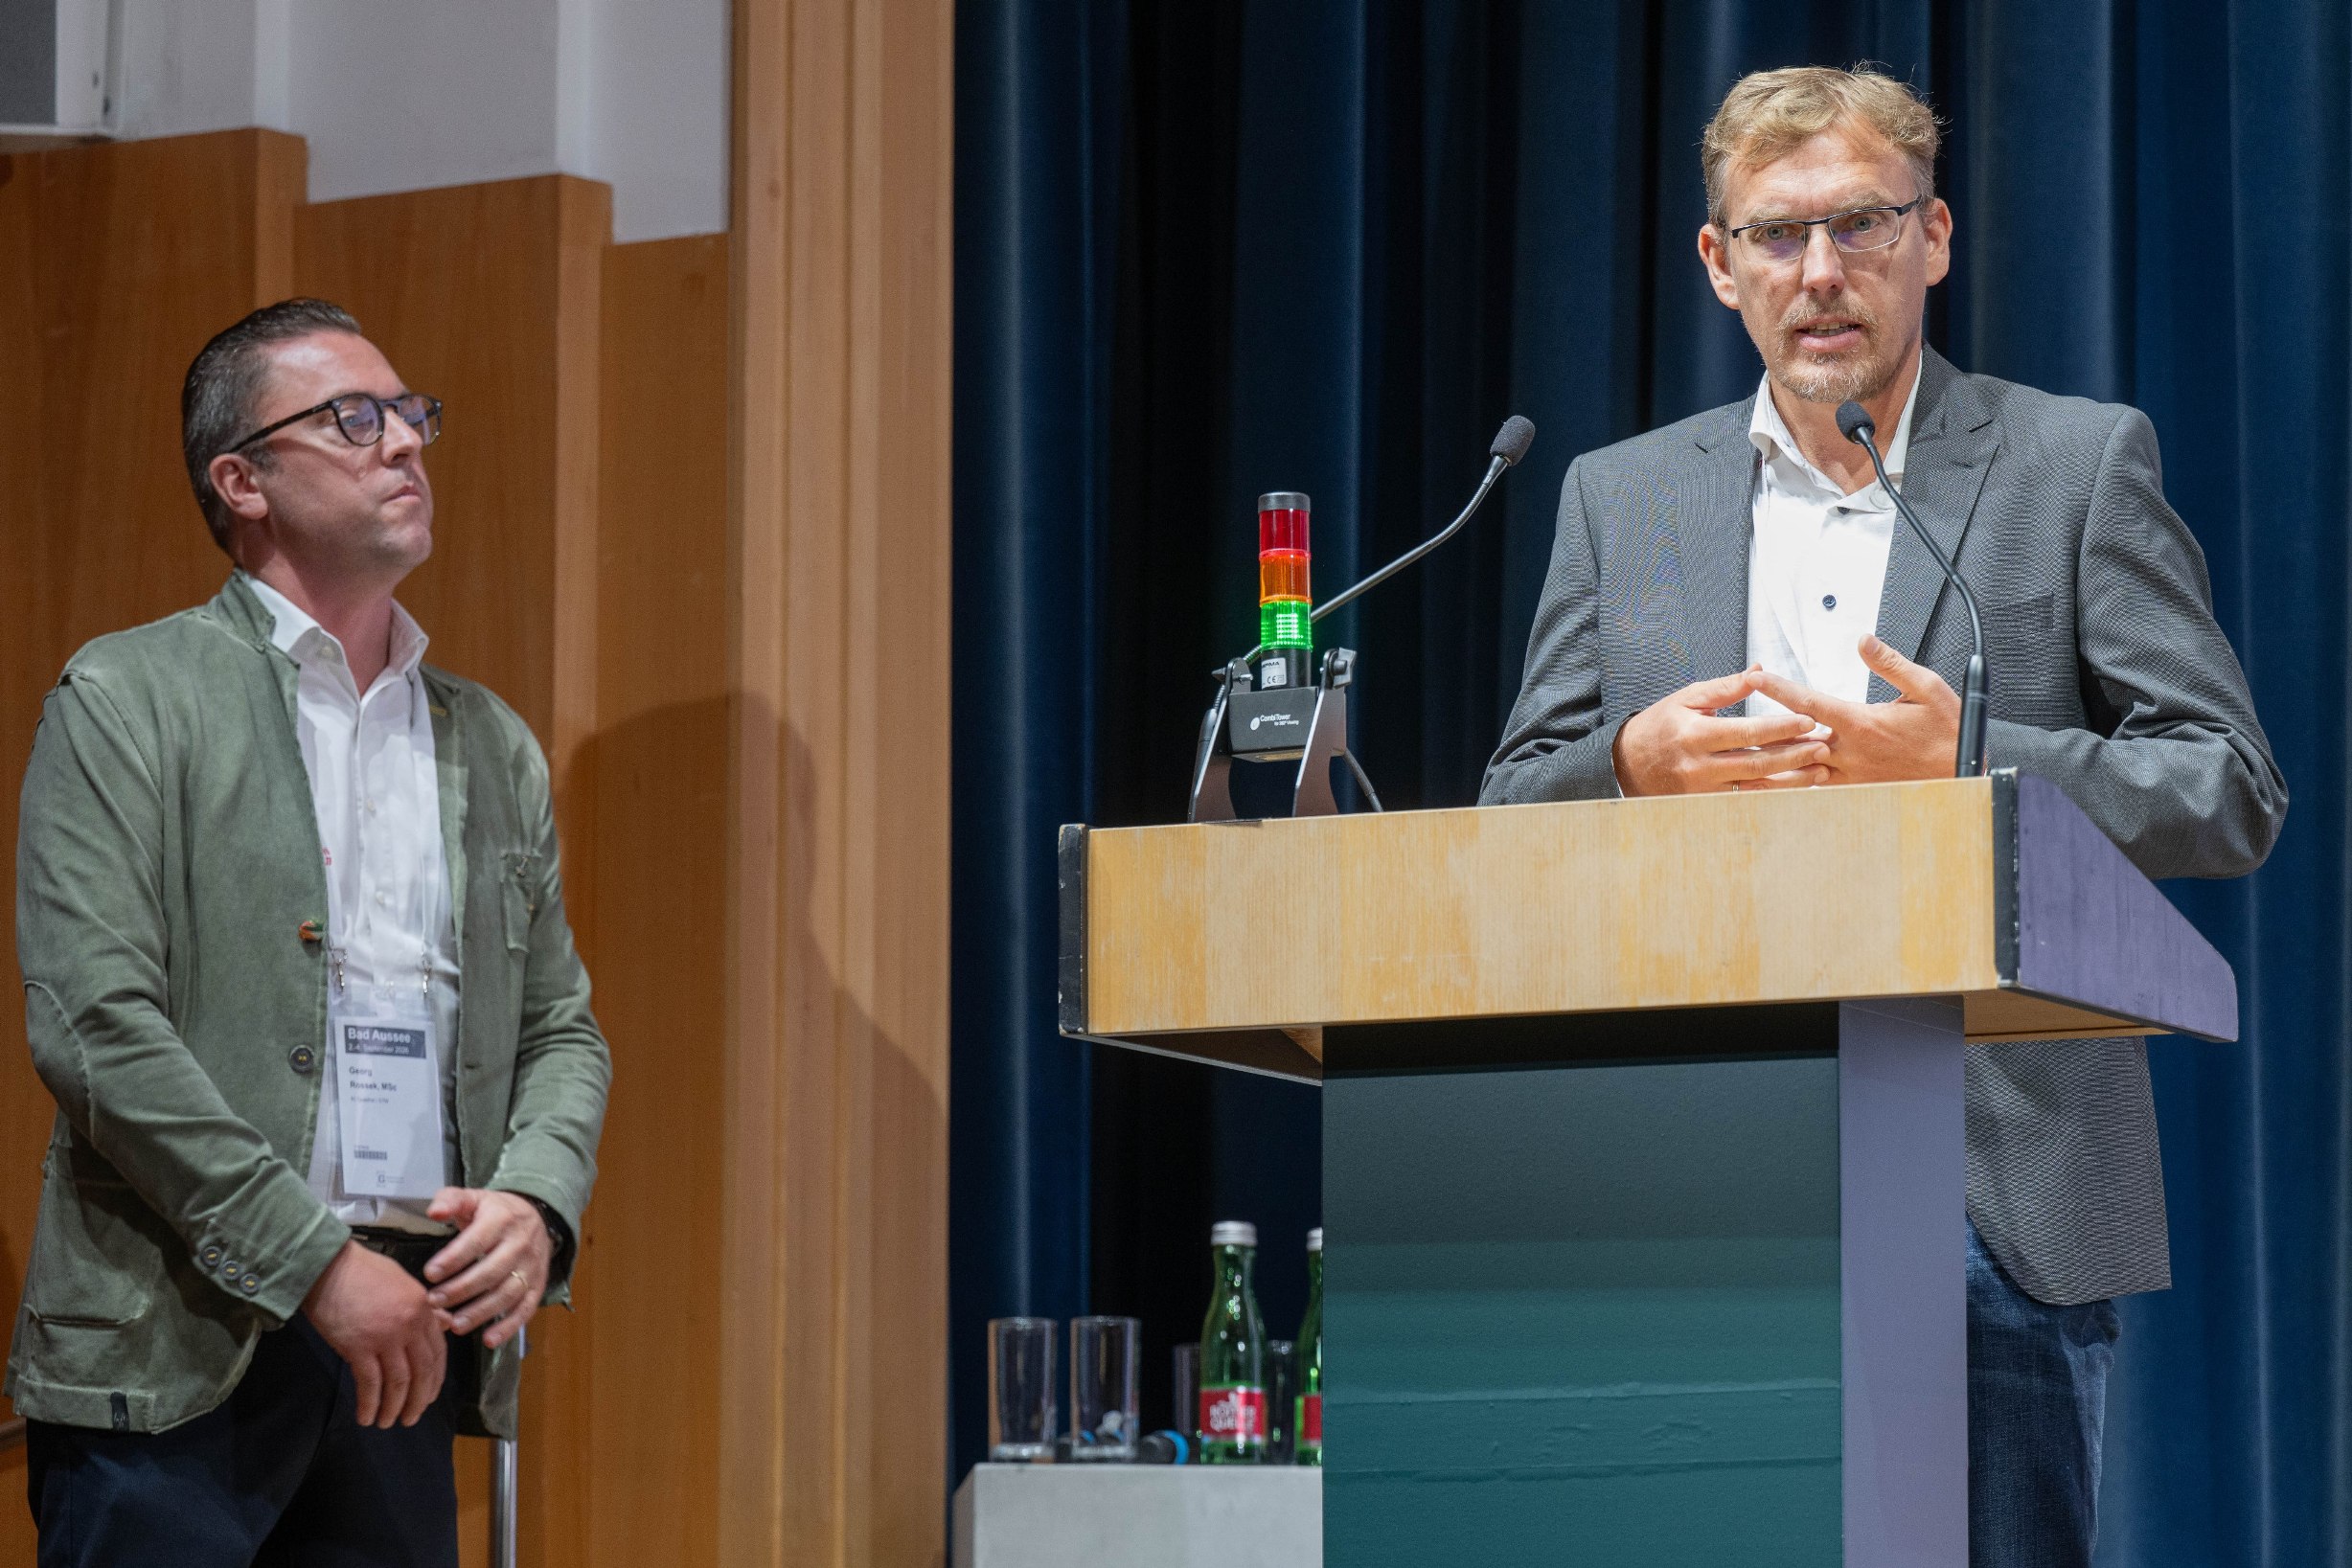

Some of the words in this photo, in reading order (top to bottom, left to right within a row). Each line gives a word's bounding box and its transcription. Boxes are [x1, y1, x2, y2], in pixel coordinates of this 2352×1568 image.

[348, 1027, 370, 1040] Bad
[372, 1030, 411, 1044] Aussee
[349, 1066, 373, 1077] Georg
